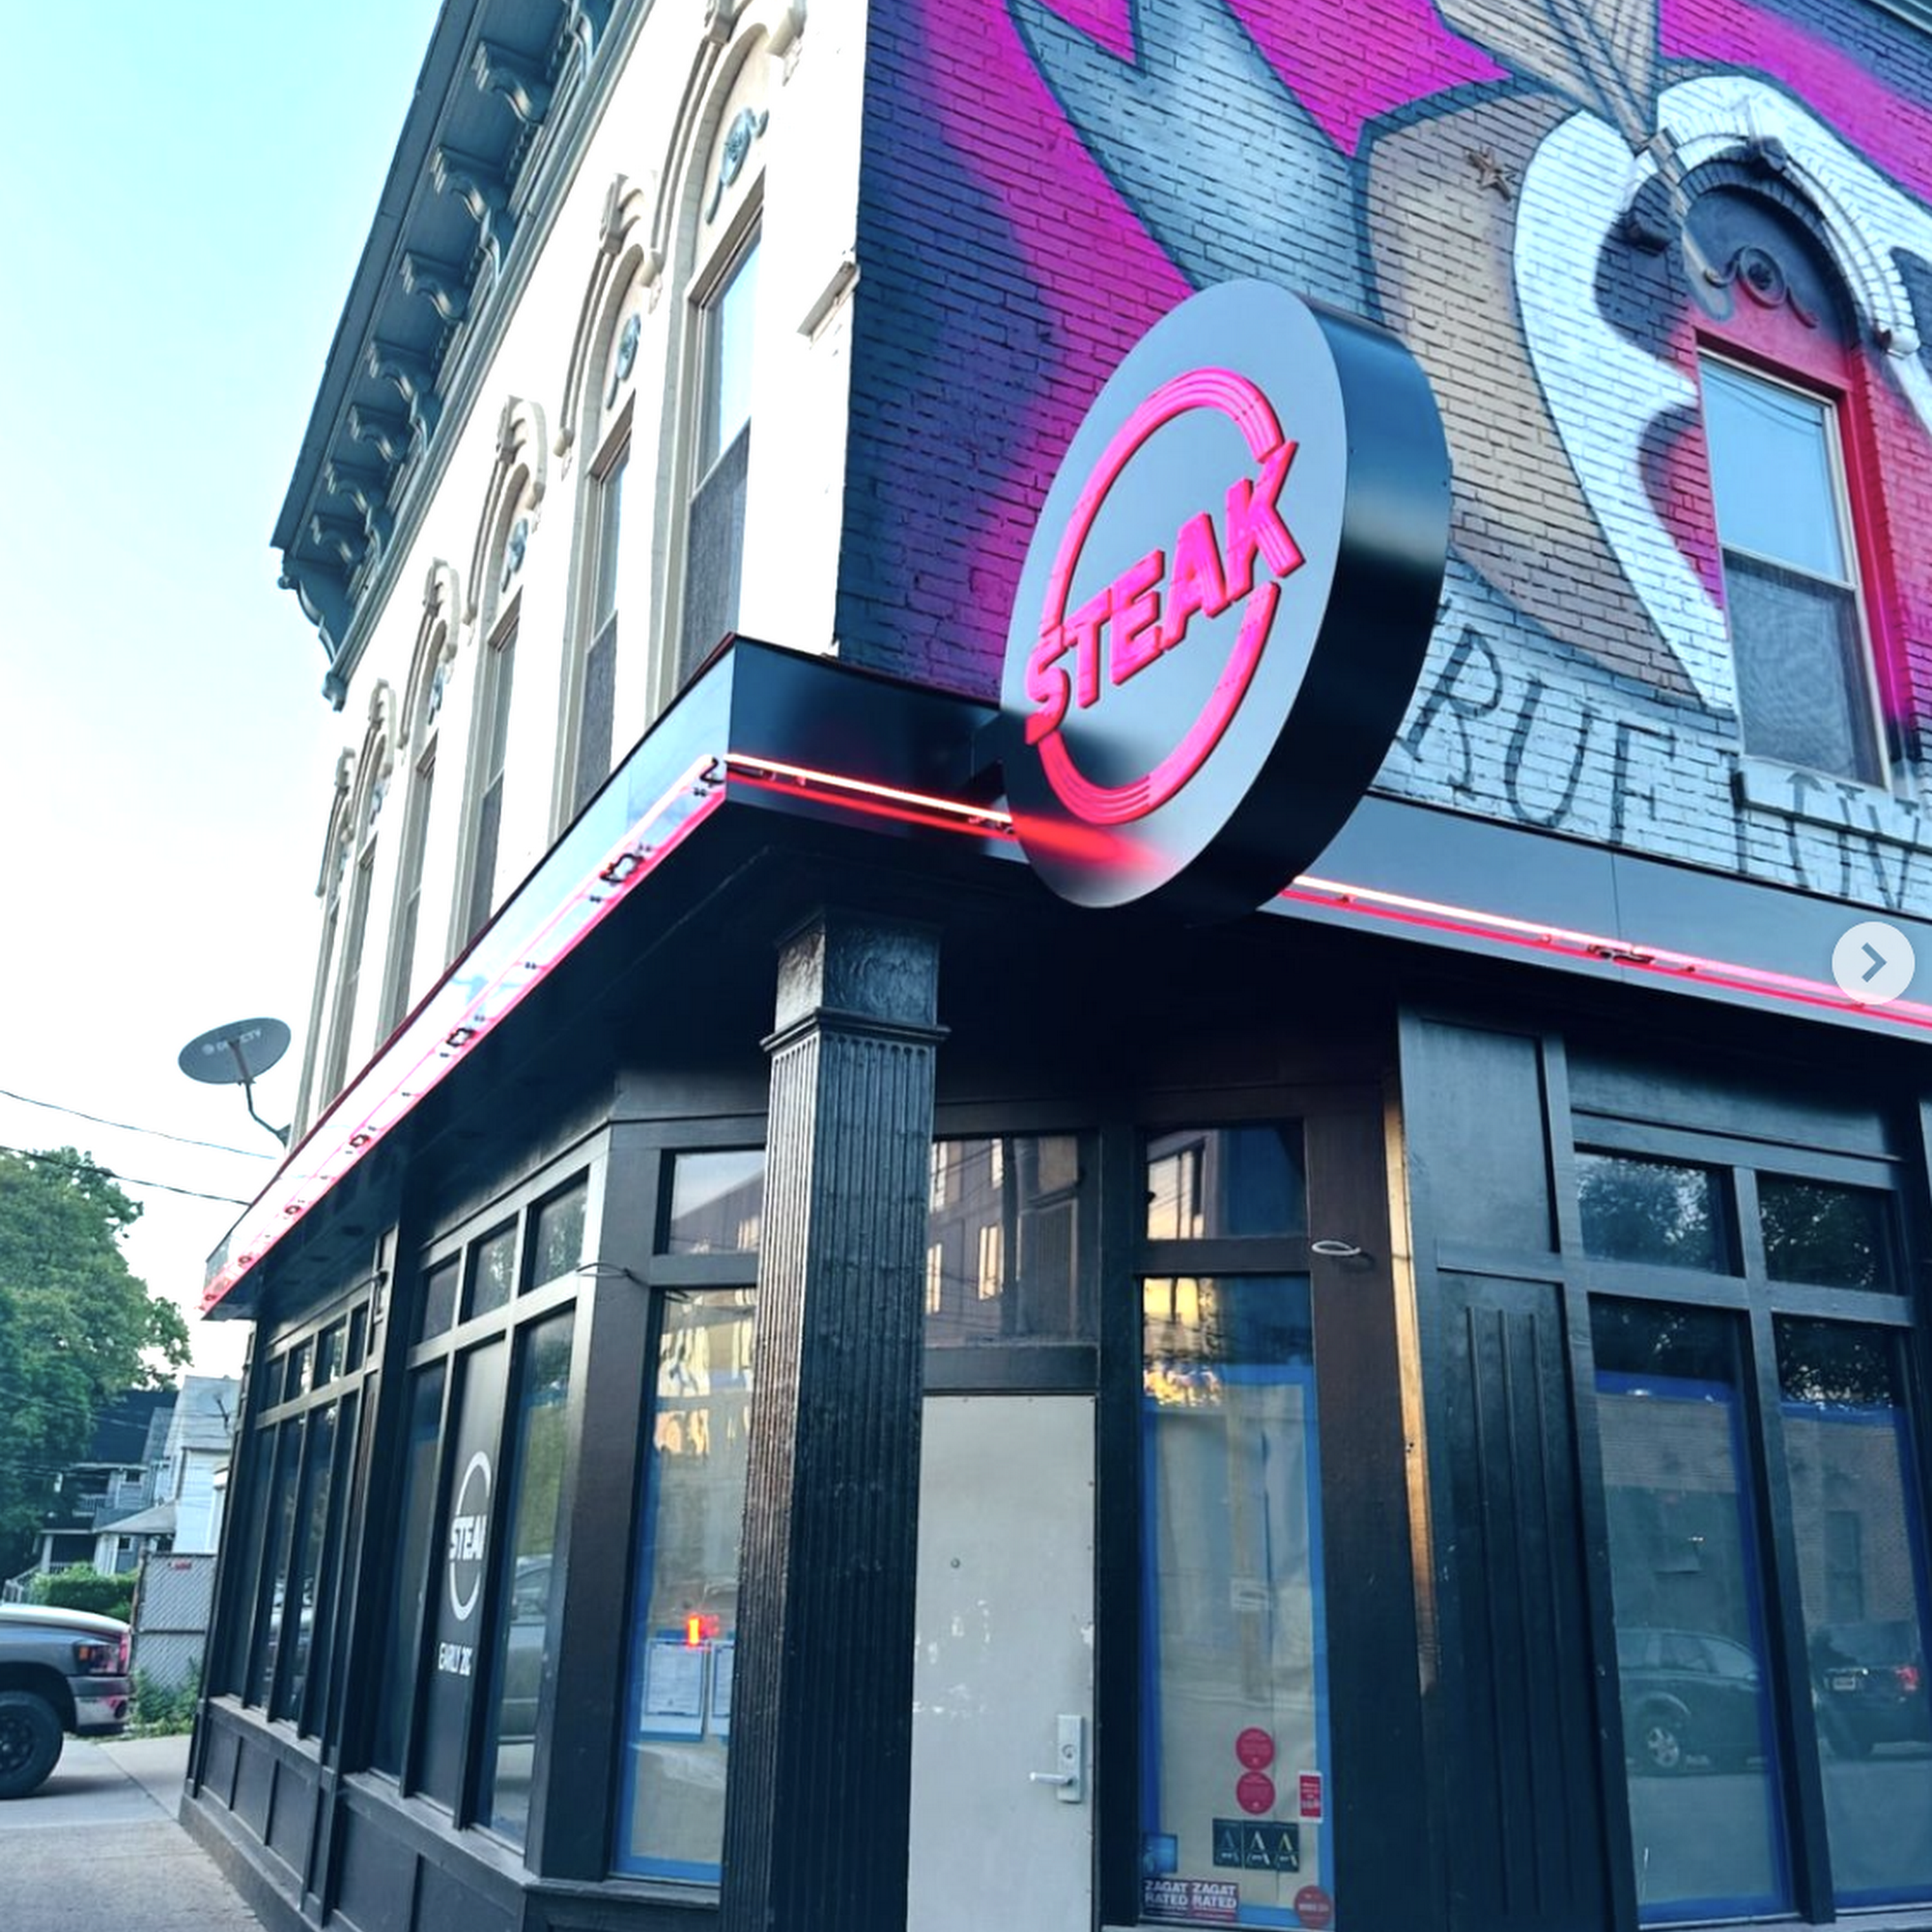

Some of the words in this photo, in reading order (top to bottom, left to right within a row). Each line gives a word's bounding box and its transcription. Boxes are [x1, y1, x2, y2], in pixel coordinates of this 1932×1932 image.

[1026, 440, 1306, 745] STEAK
[1144, 1881, 1188, 1893] ZAGAT
[1192, 1882, 1237, 1896] ZAGAT
[1145, 1891, 1189, 1907] RATED
[1192, 1895, 1237, 1909] RATED
